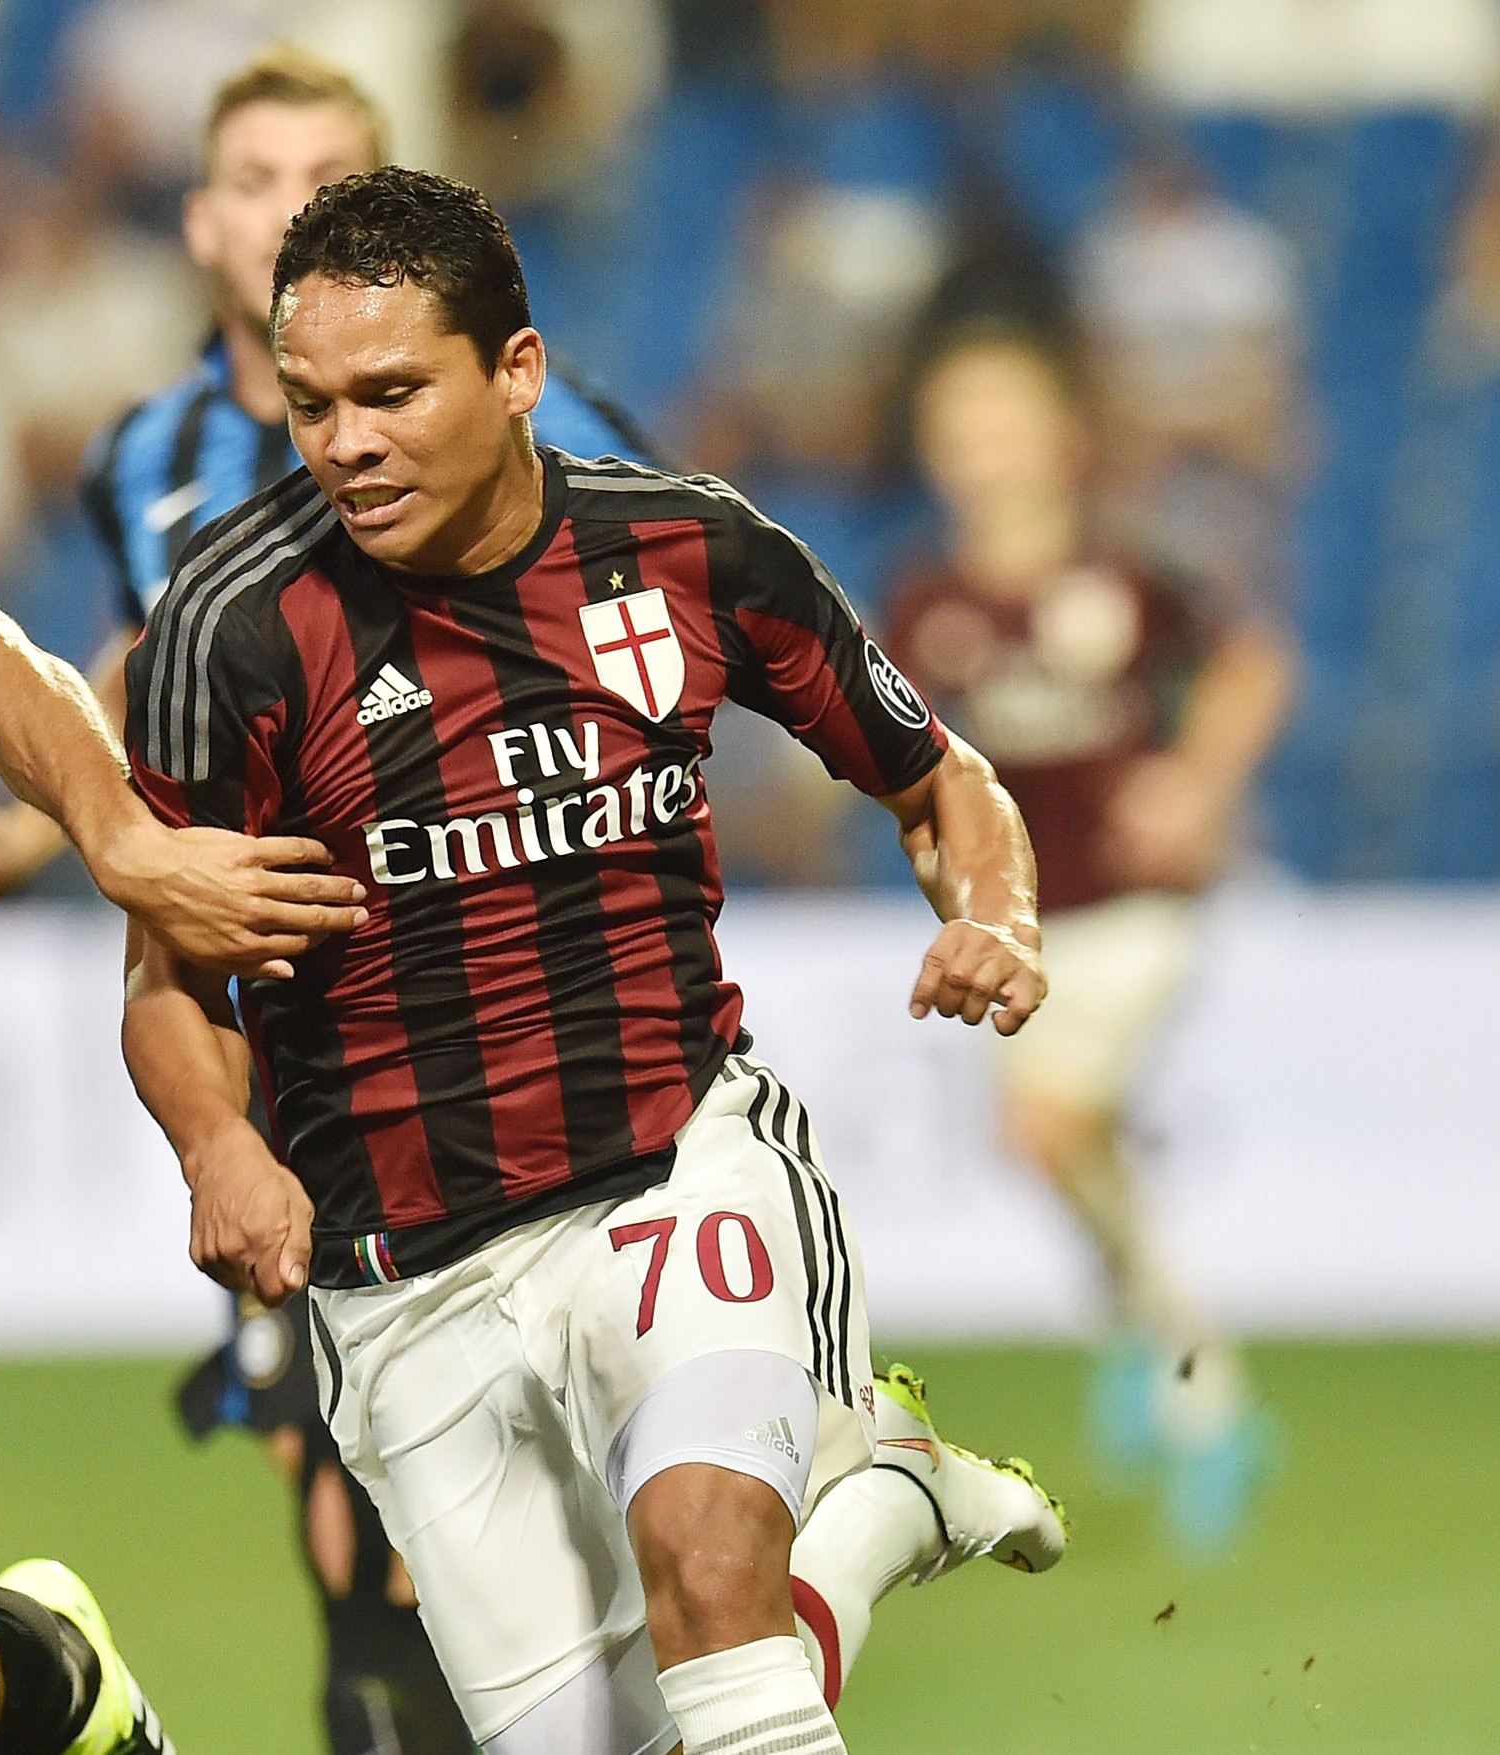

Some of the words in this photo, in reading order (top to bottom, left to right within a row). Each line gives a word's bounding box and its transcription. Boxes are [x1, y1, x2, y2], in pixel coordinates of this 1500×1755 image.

[356, 689, 434, 726] adidas
[487, 721, 600, 787] Fly
[363, 753, 703, 885] Emirates
[608, 1211, 775, 1340] 70
